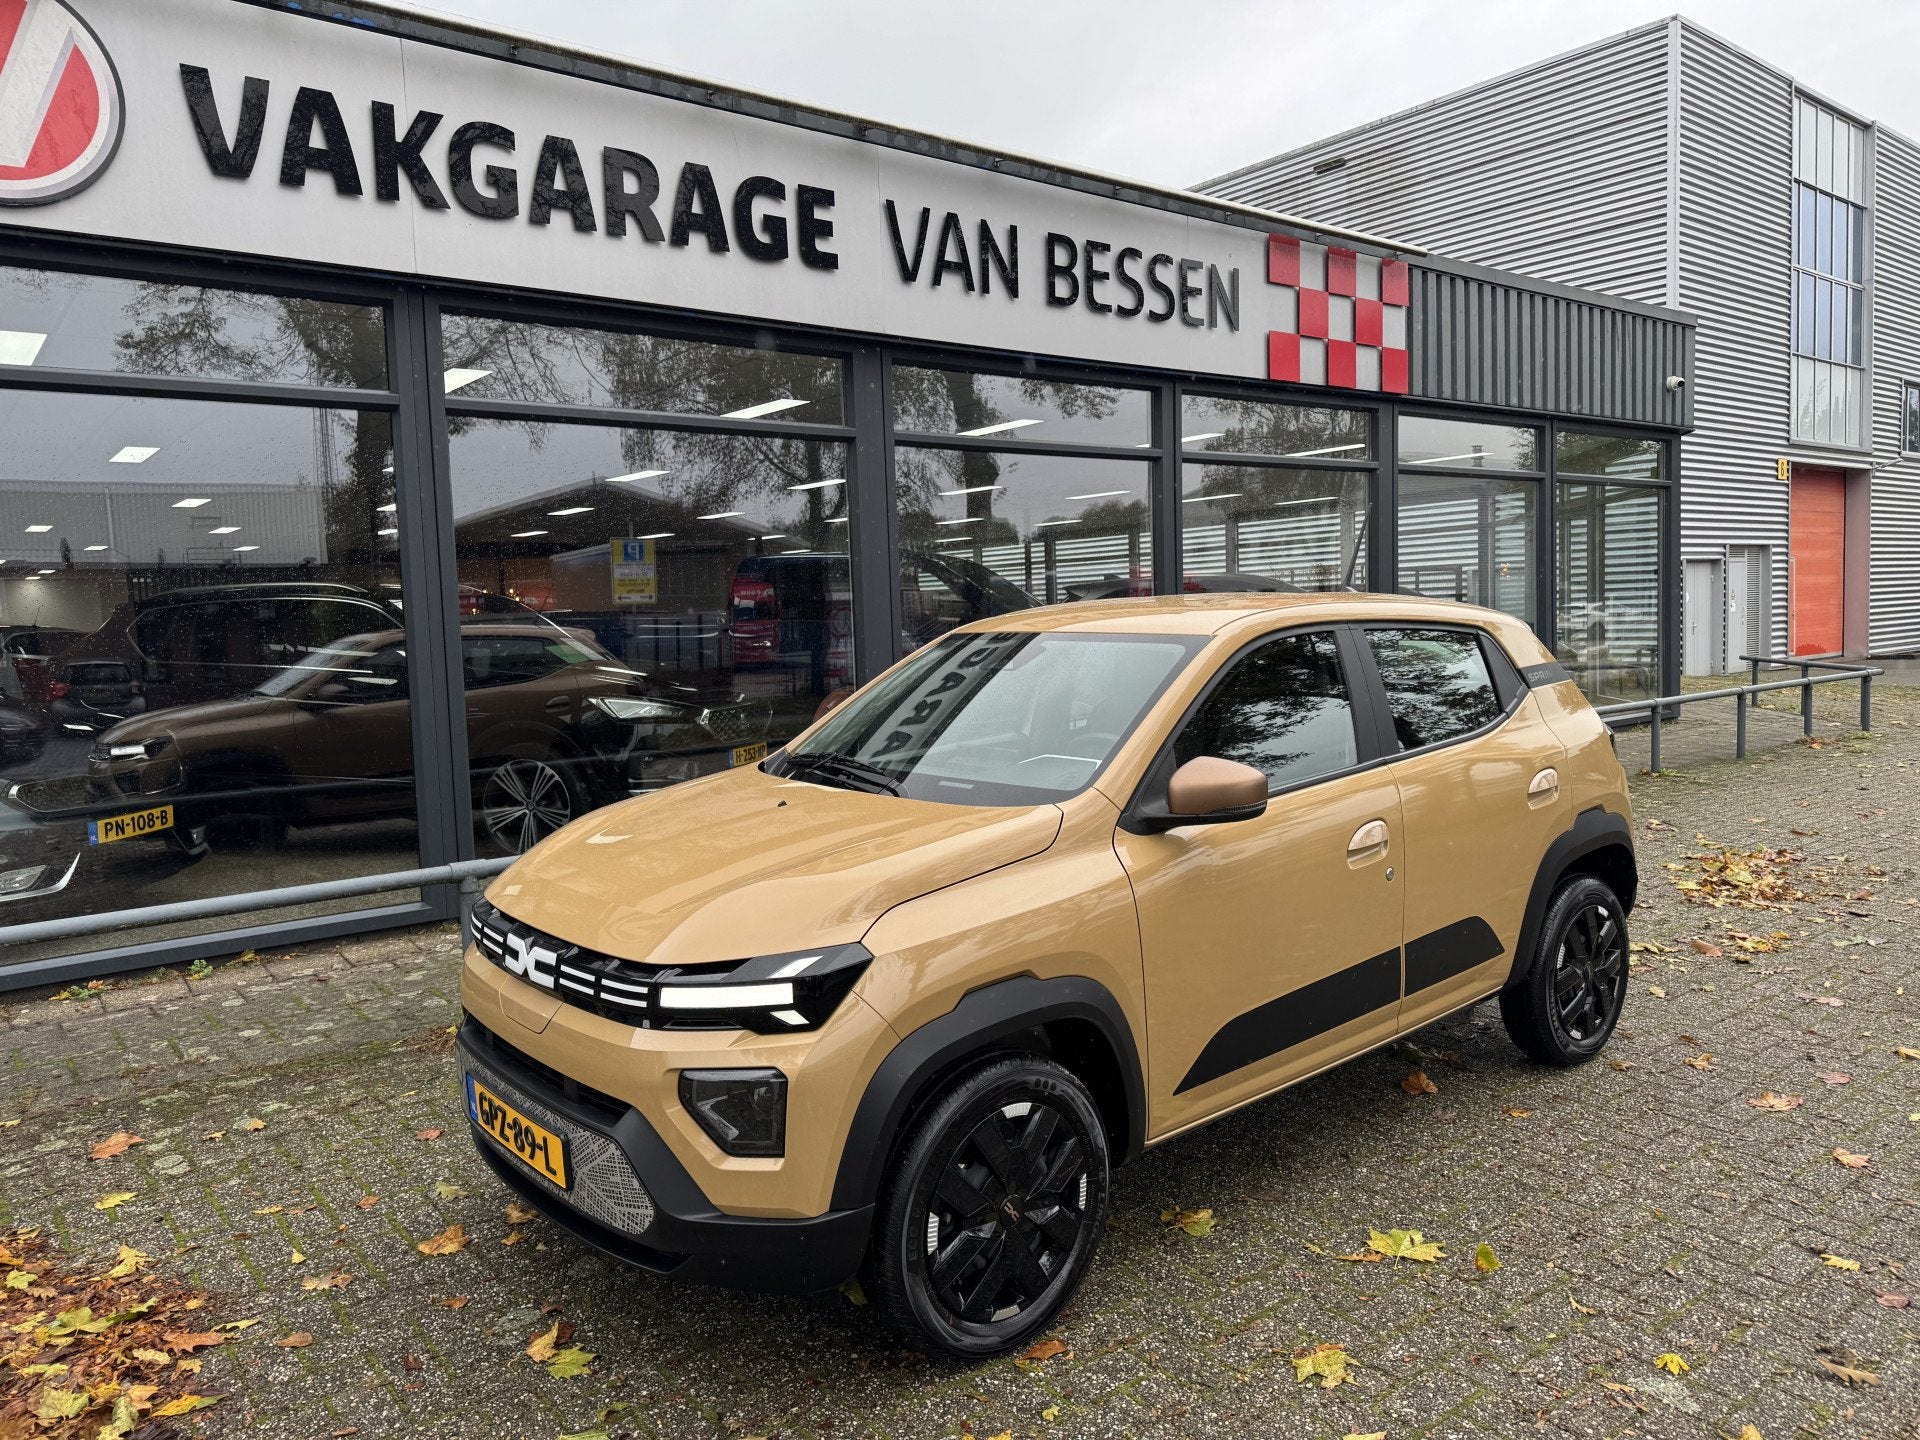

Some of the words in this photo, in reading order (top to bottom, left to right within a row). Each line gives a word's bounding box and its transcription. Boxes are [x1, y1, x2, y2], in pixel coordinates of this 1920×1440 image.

[180, 63, 839, 270] VAKGARAGE
[886, 199, 1019, 298] VAN
[1048, 231, 1239, 332] BESSEN
[104, 809, 169, 839] PN-108-B
[478, 1091, 557, 1176] GPZ-89-L
